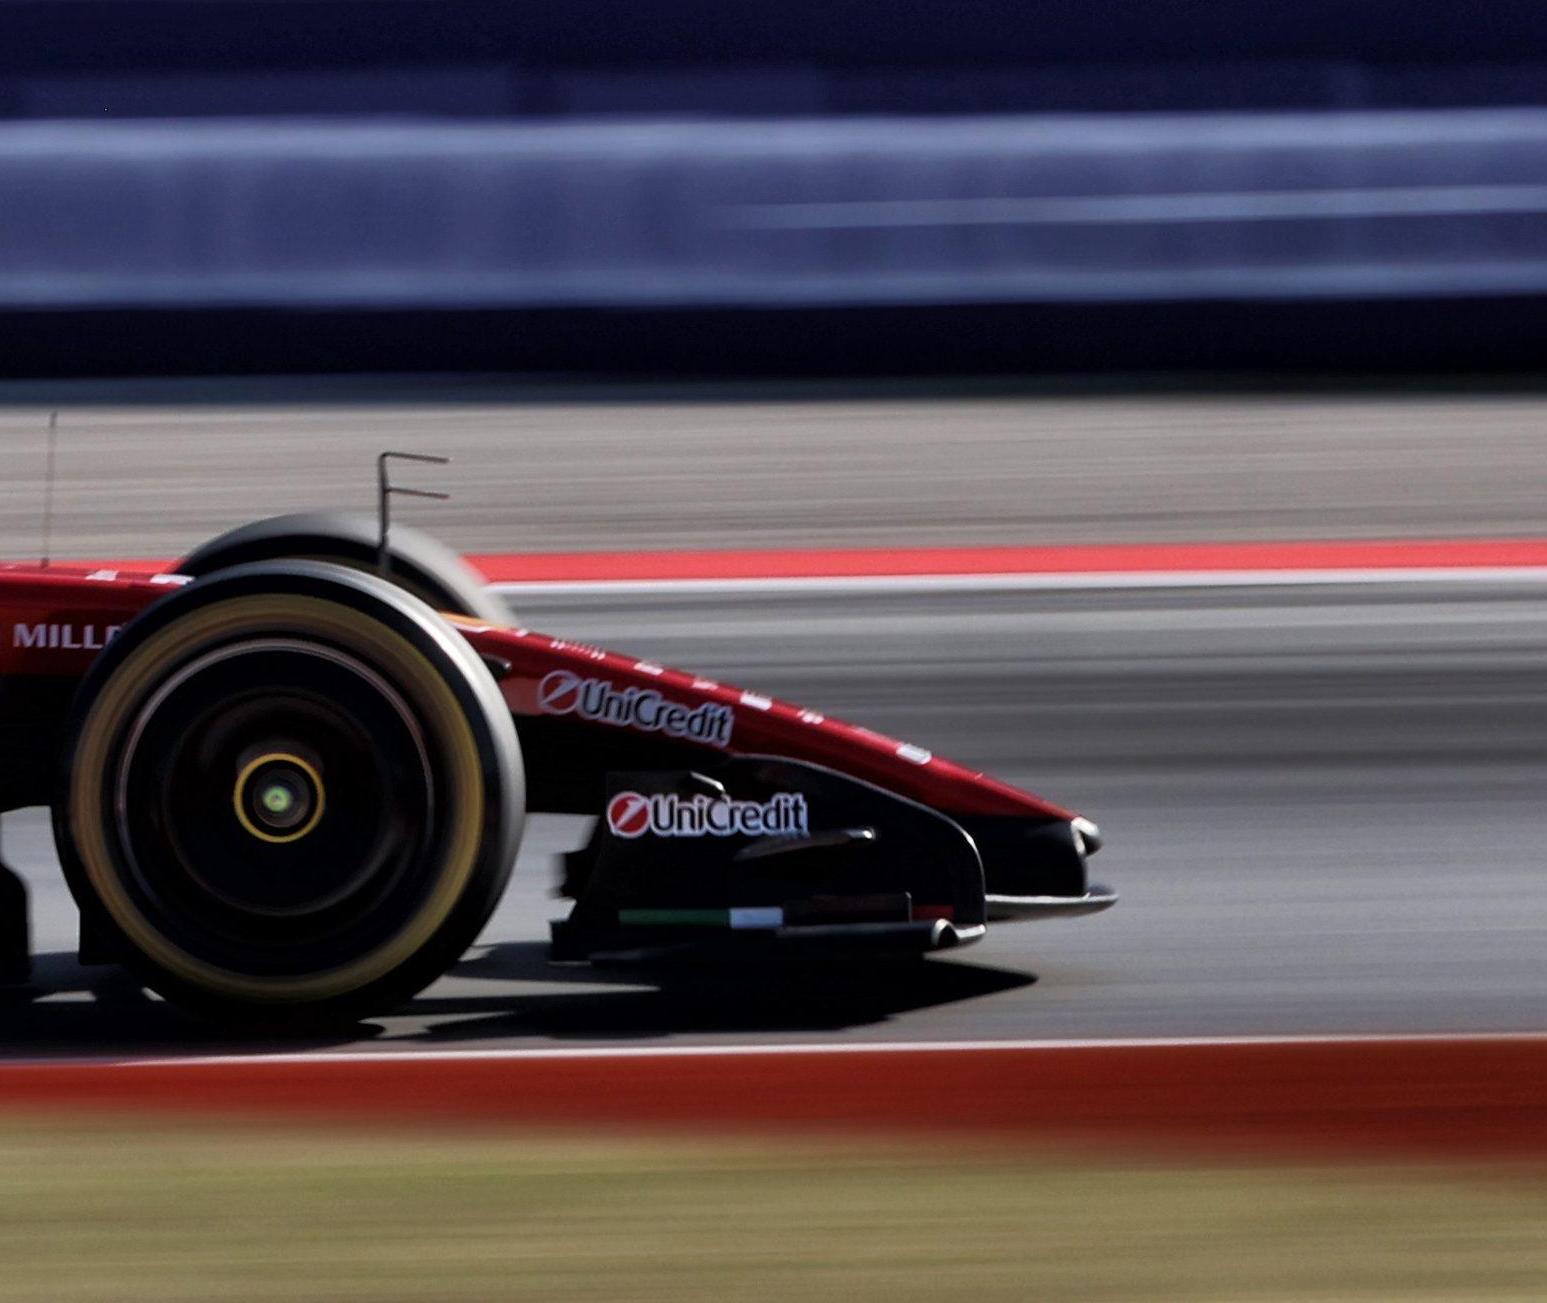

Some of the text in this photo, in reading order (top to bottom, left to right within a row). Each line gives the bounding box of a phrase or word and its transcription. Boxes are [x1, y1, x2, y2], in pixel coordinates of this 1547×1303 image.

[12, 622, 123, 649] MILL
[580, 678, 735, 747] UniCredit
[648, 793, 807, 836] UniCredit
